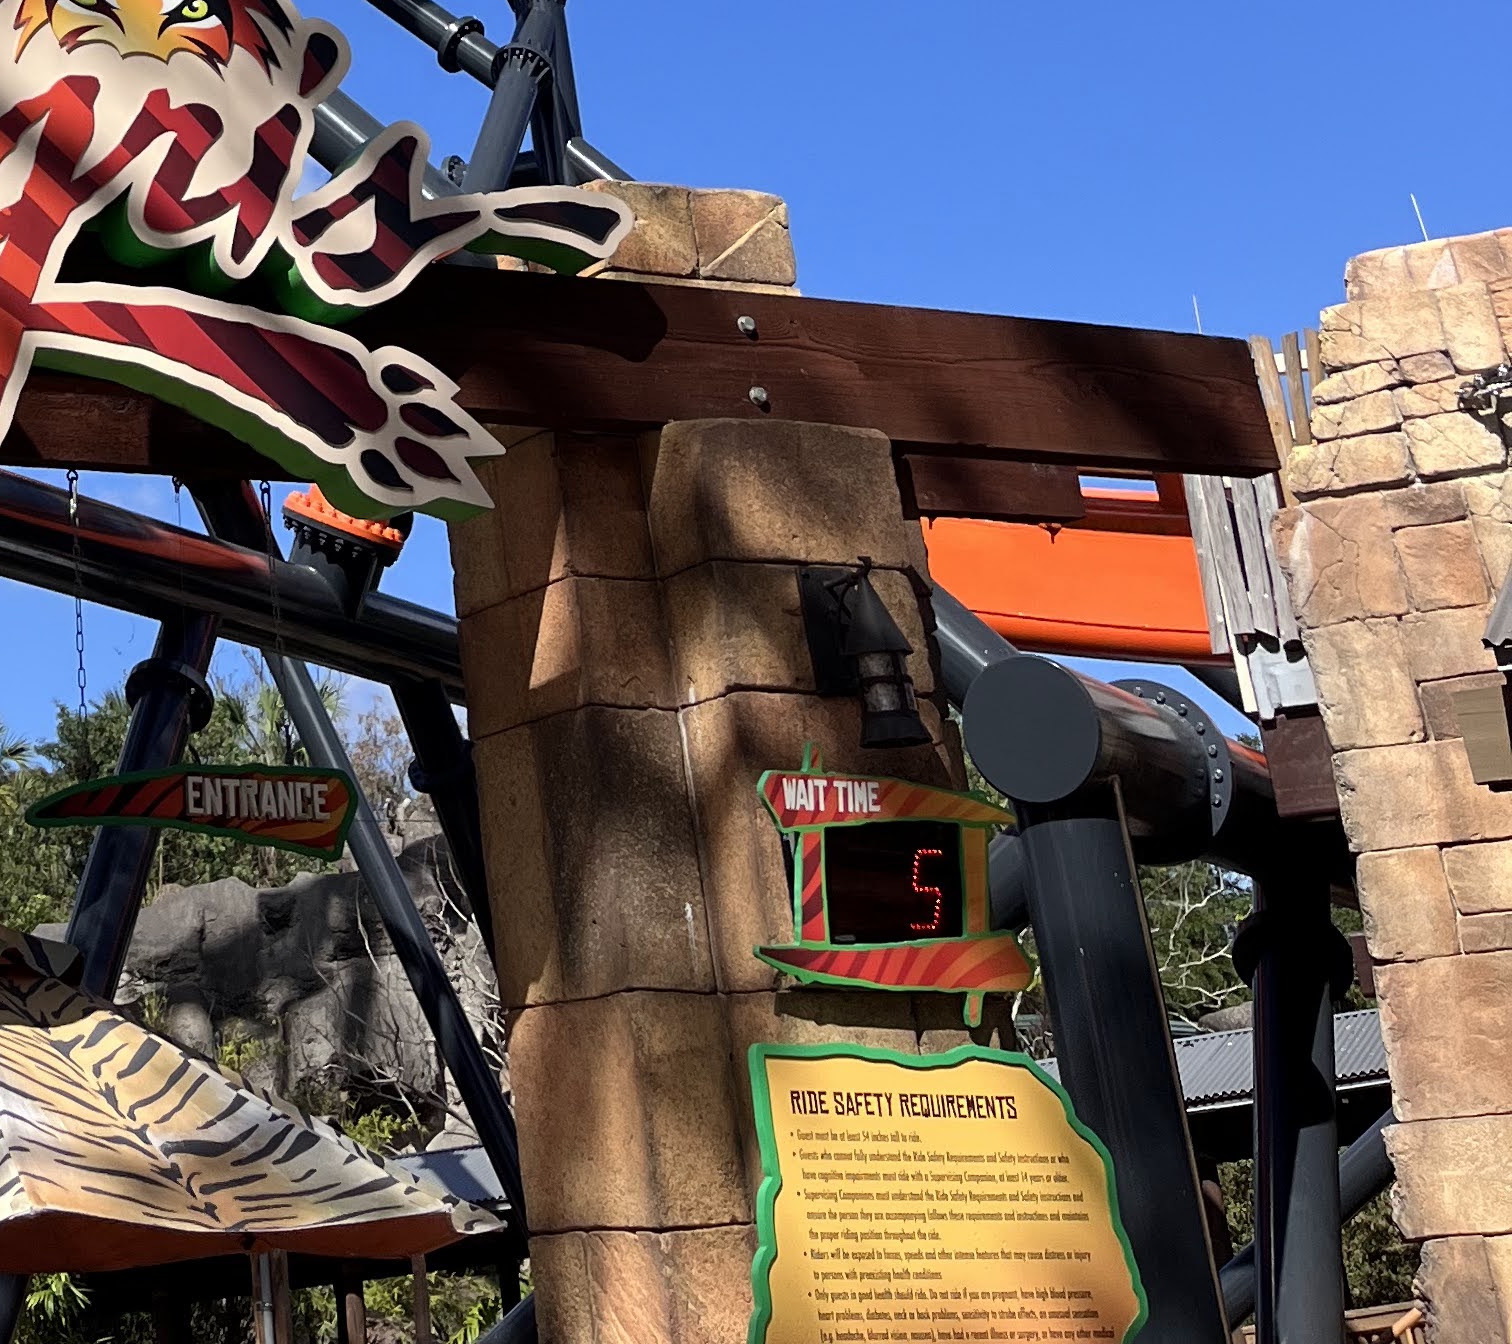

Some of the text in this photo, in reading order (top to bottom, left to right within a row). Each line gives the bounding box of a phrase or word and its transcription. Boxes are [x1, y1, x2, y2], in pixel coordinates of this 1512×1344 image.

[186, 775, 331, 820] ENTRANCE
[782, 777, 881, 813] WAIT TIME
[910, 848, 943, 930] 5
[790, 1090, 1018, 1119] RIDE SAFETY REQUIREMENTS
